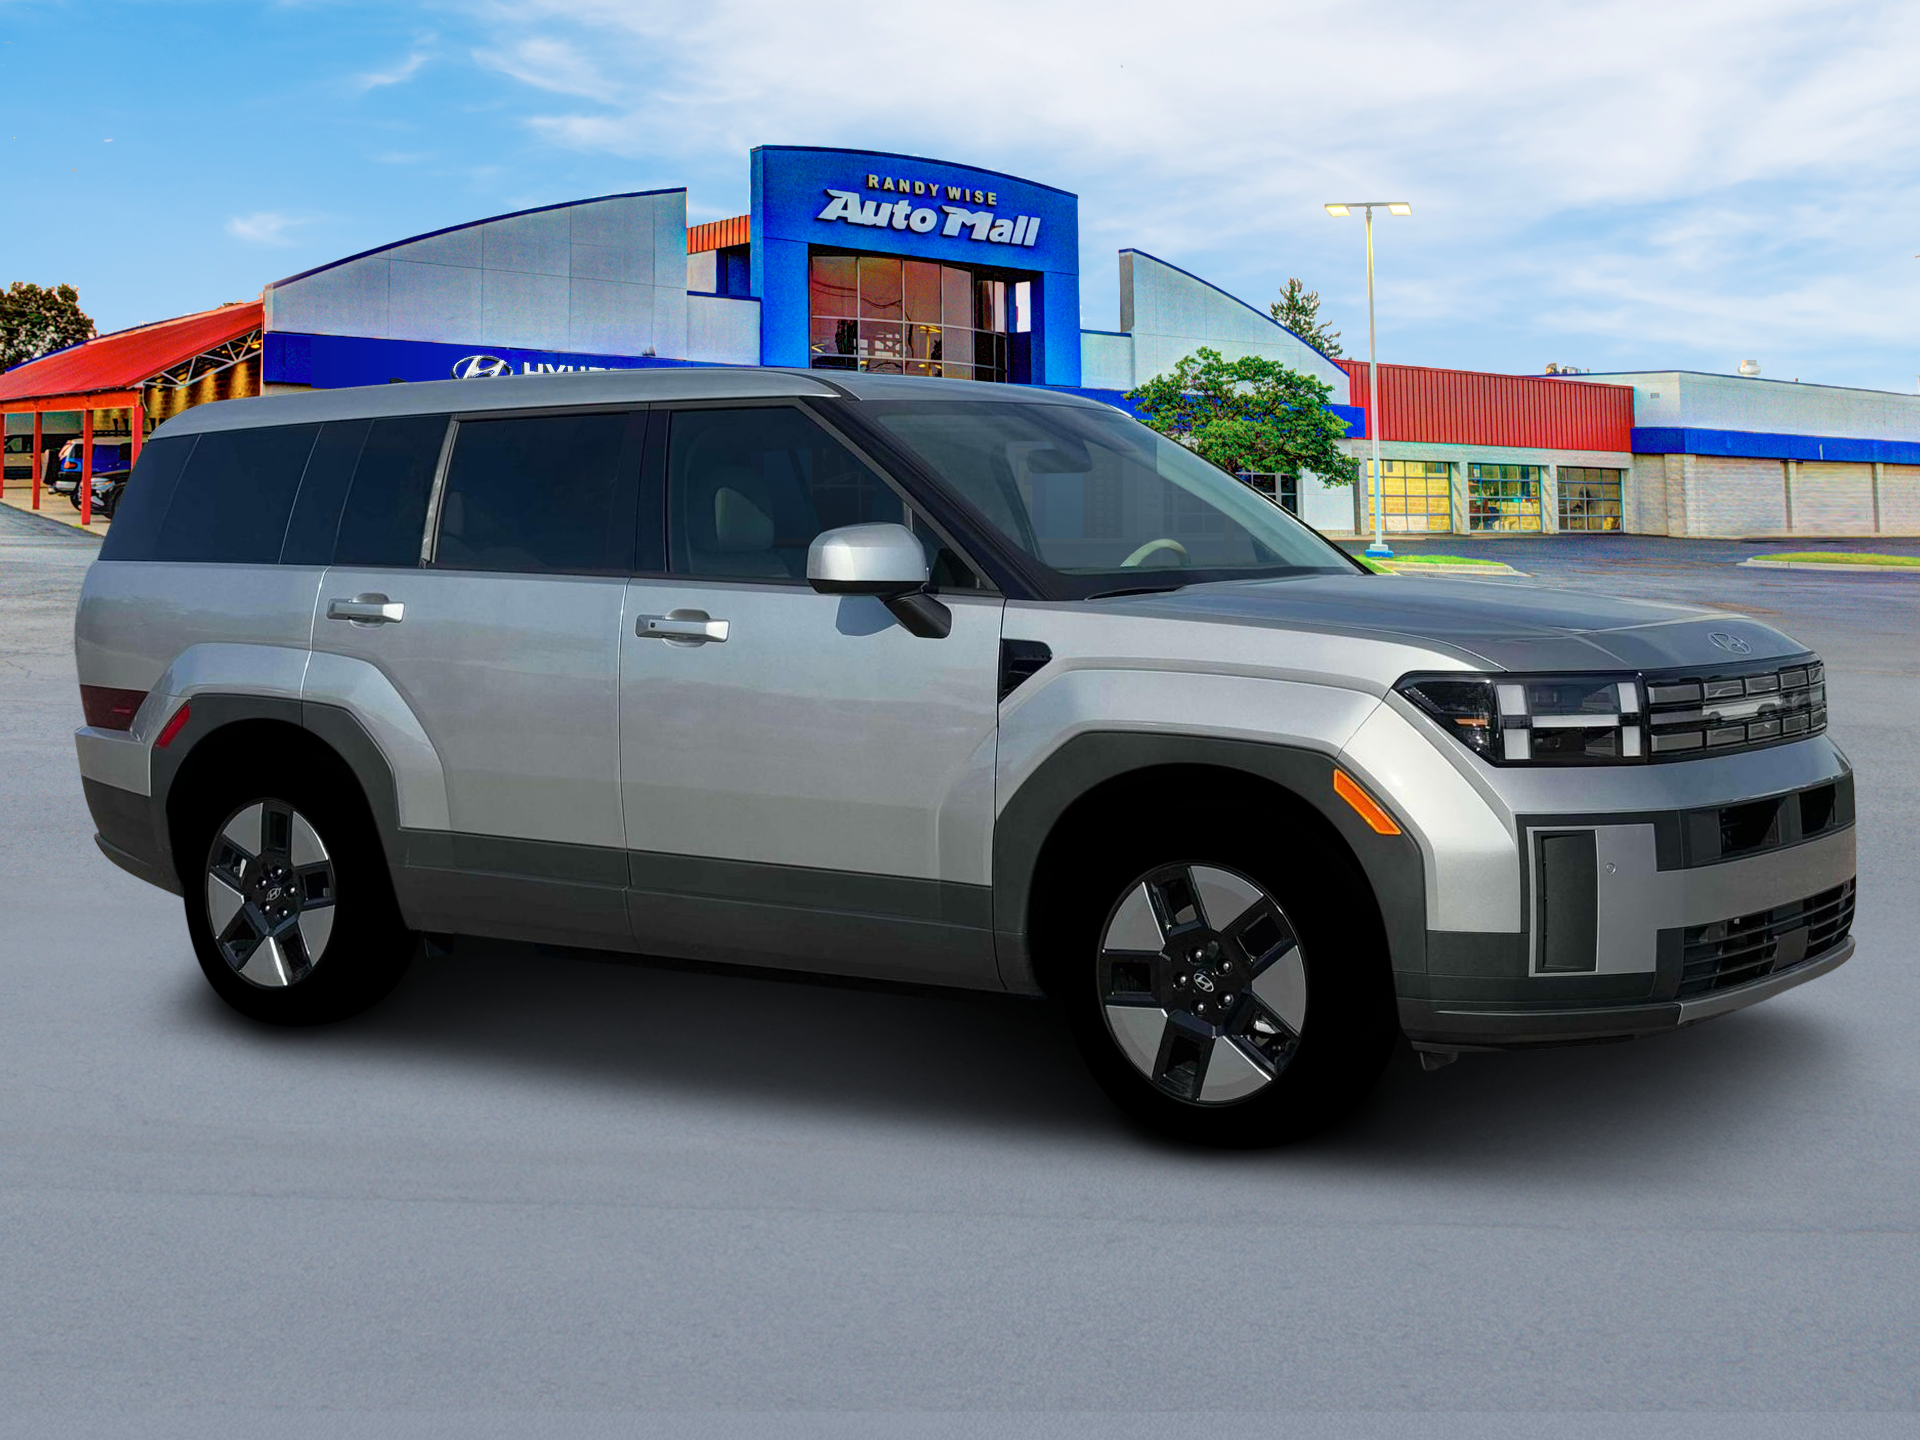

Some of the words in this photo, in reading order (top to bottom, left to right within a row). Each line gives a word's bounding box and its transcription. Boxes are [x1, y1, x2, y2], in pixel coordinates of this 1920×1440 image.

[867, 174, 939, 196] RANDY
[946, 186, 997, 205] WISE
[817, 189, 938, 232] Auto
[941, 205, 1041, 246] Mall
